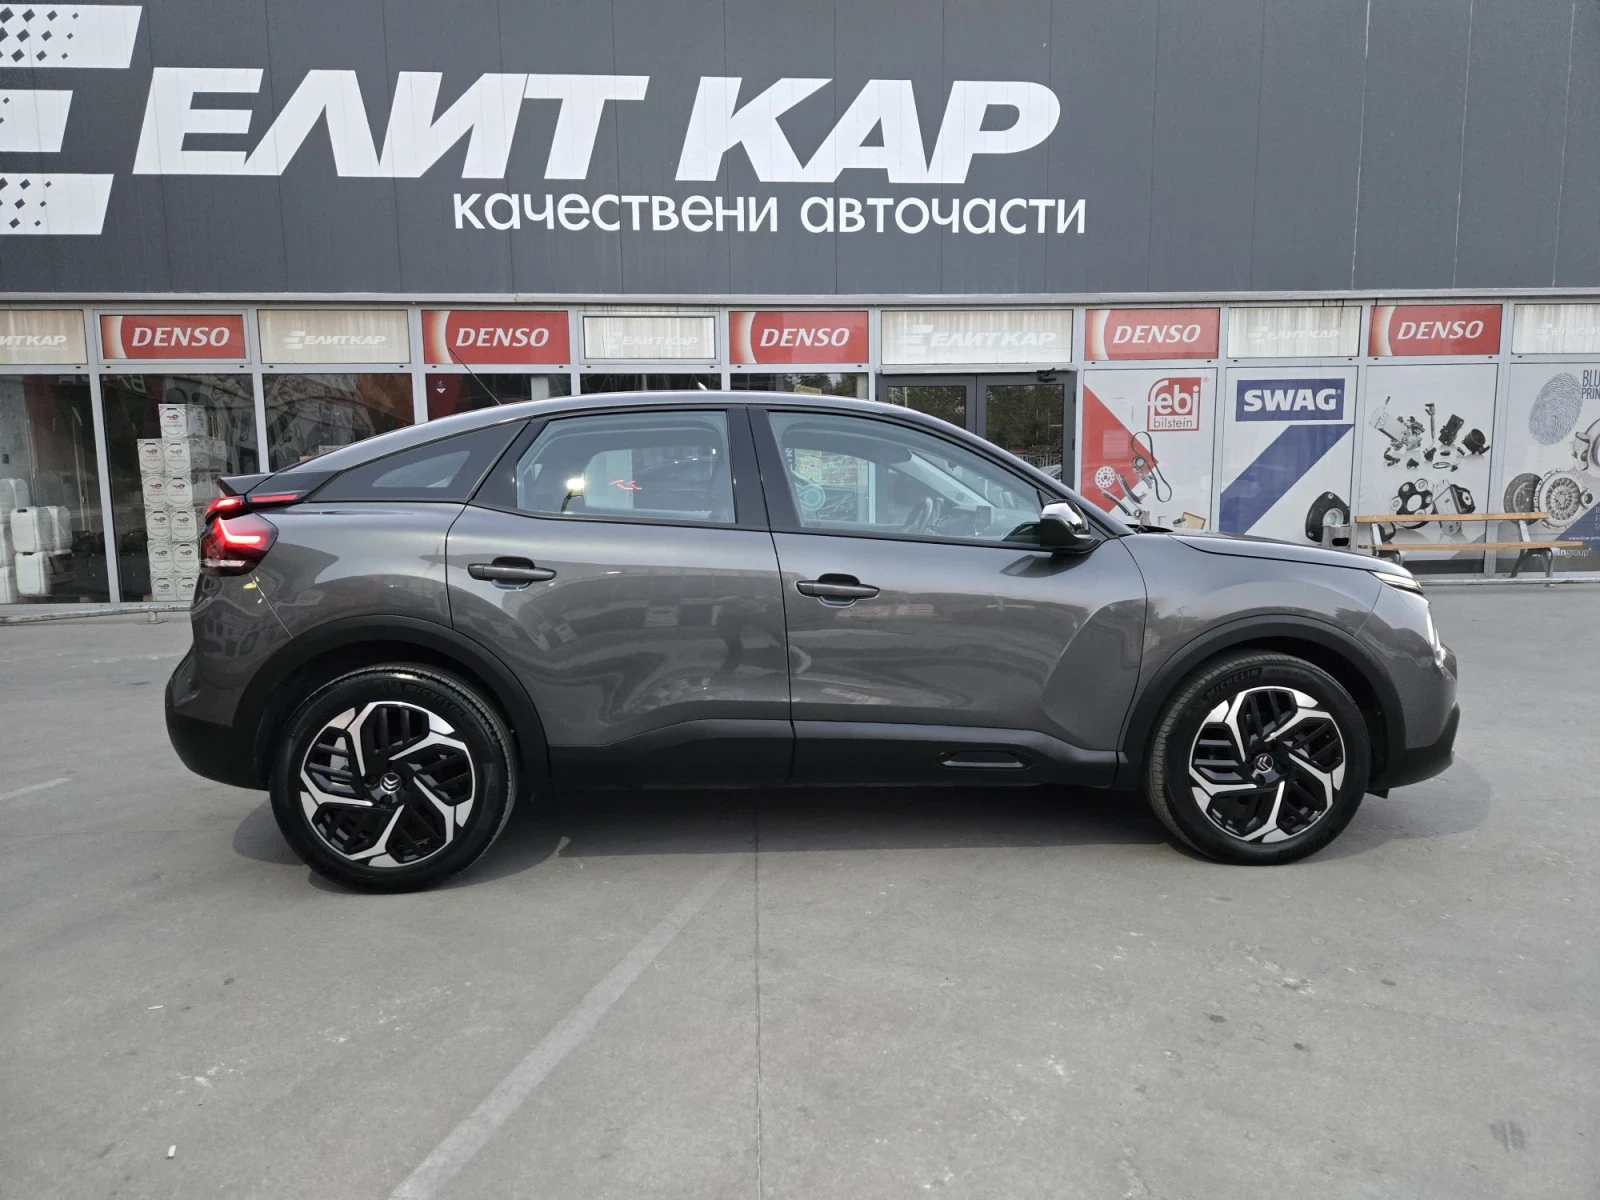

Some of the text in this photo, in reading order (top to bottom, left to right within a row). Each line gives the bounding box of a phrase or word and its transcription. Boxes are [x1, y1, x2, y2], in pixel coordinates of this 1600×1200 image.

[132, 67, 1061, 185] ЕЛИТ КАР
[453, 192, 1086, 235] качествени авточасти
[132, 327, 230, 347] DENSO
[455, 327, 550, 347] DENSO
[760, 327, 850, 347] DENSO
[1112, 324, 1201, 344] DENSO
[1397, 320, 1484, 340] DENSO
[1147, 379, 1200, 416] febi
[1153, 417, 1193, 429] bilstein
